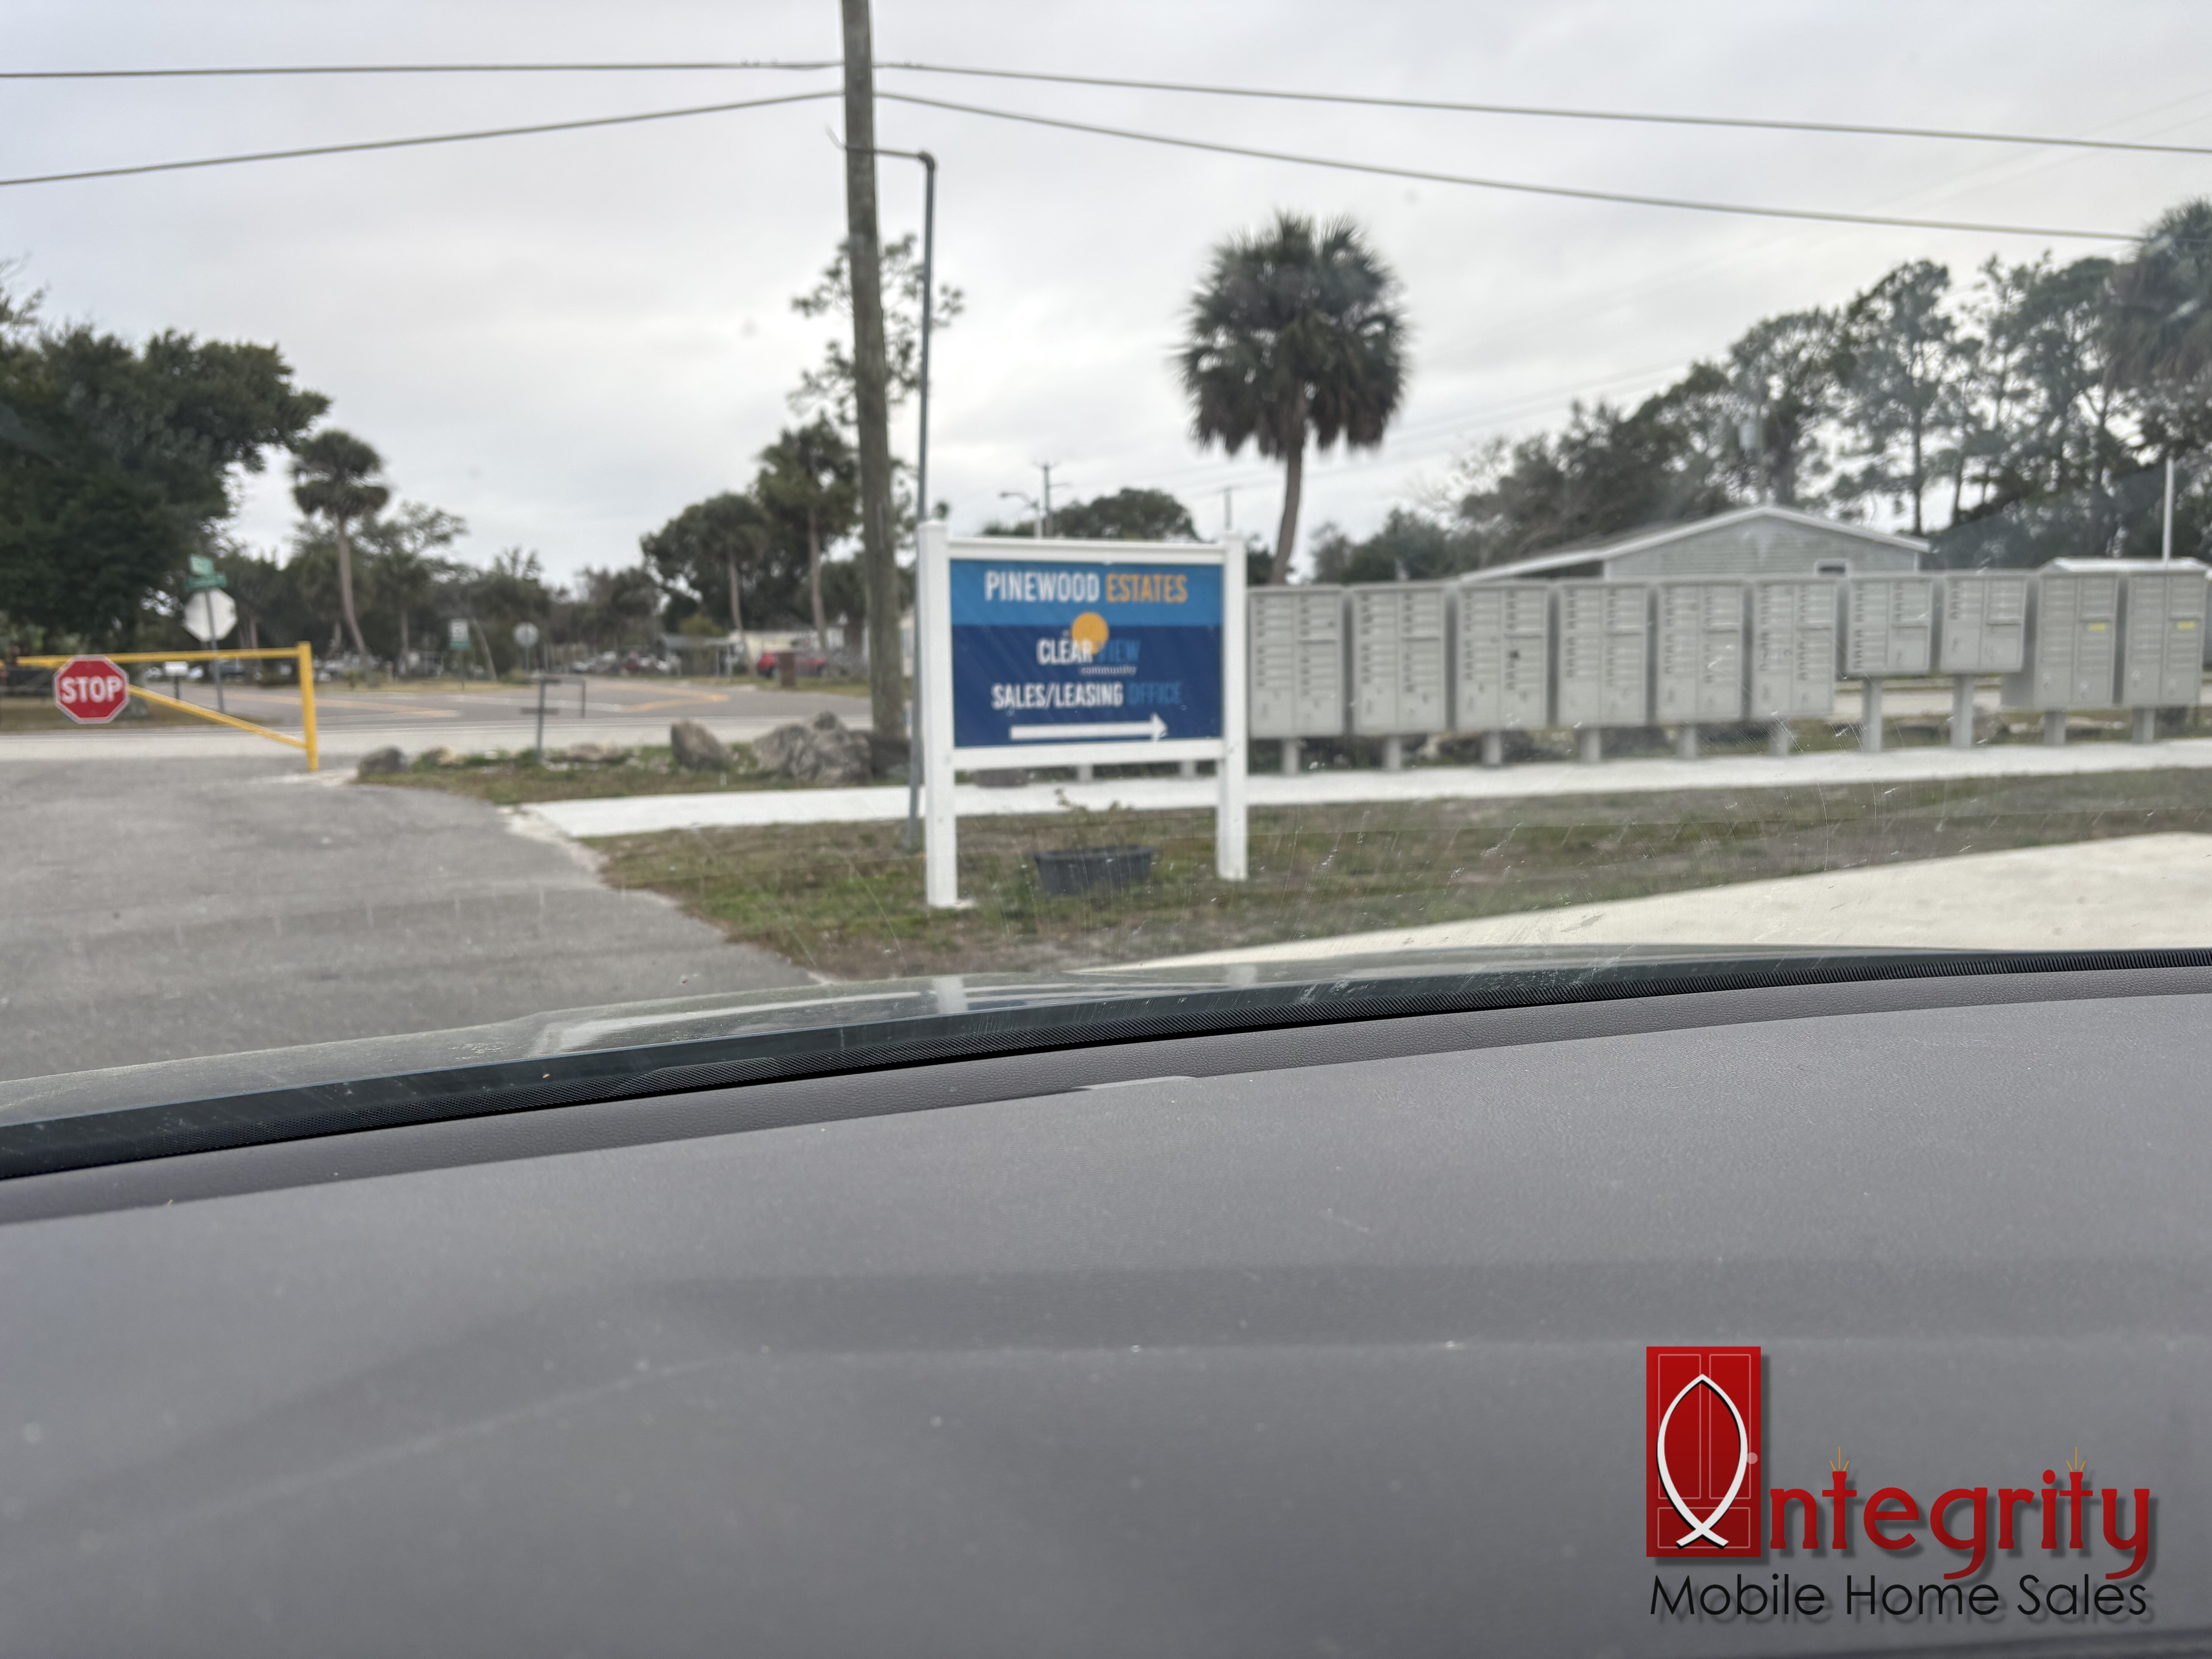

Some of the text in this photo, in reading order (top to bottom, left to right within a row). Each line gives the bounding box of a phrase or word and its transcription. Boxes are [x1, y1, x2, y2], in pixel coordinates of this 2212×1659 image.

[986, 571, 1187, 603] PINEWOOD ESTATES
[61, 676, 123, 702] STOP
[992, 682, 1180, 708] SALES/LEASING OFFICE
